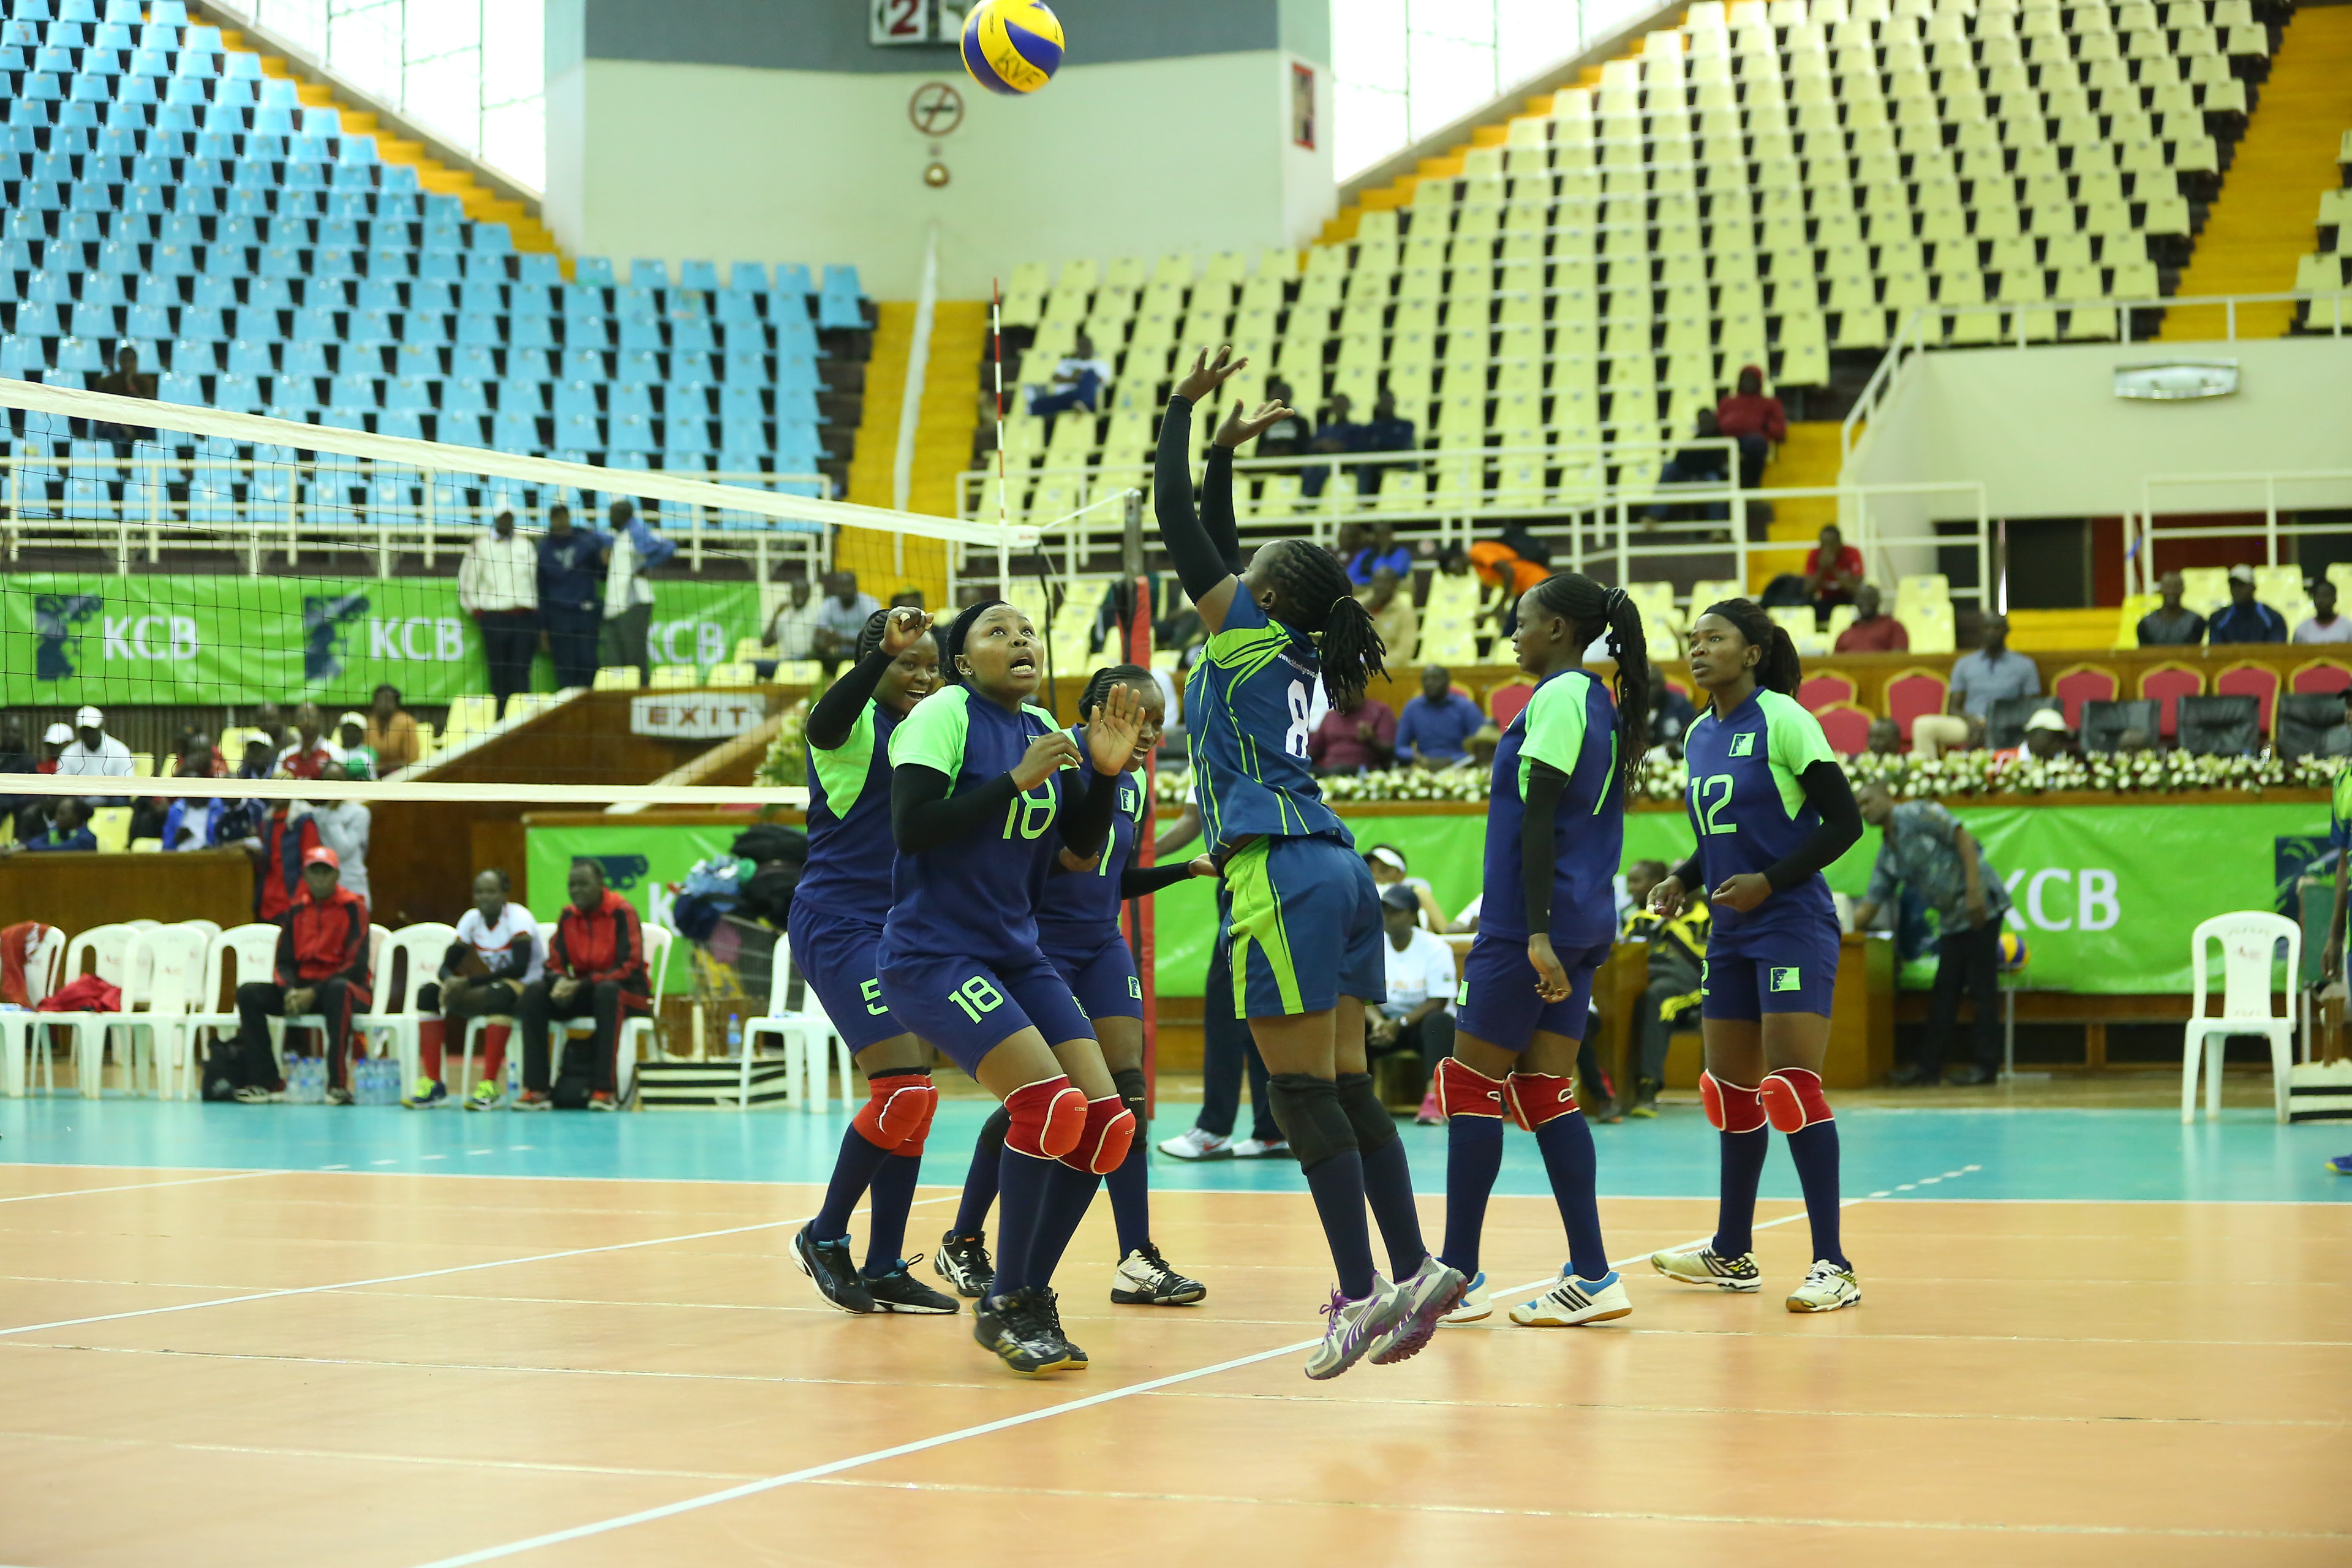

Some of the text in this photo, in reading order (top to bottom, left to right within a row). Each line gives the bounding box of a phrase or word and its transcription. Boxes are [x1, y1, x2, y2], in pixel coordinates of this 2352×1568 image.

[103, 615, 199, 660] KCB
[370, 616, 464, 662] KCB
[649, 707, 747, 726] EXIT
[1286, 679, 1309, 759] 8
[1003, 777, 1057, 840] 18
[1691, 774, 1737, 835] 12
[859, 978, 889, 1016] 5
[948, 975, 1005, 1025] 18
